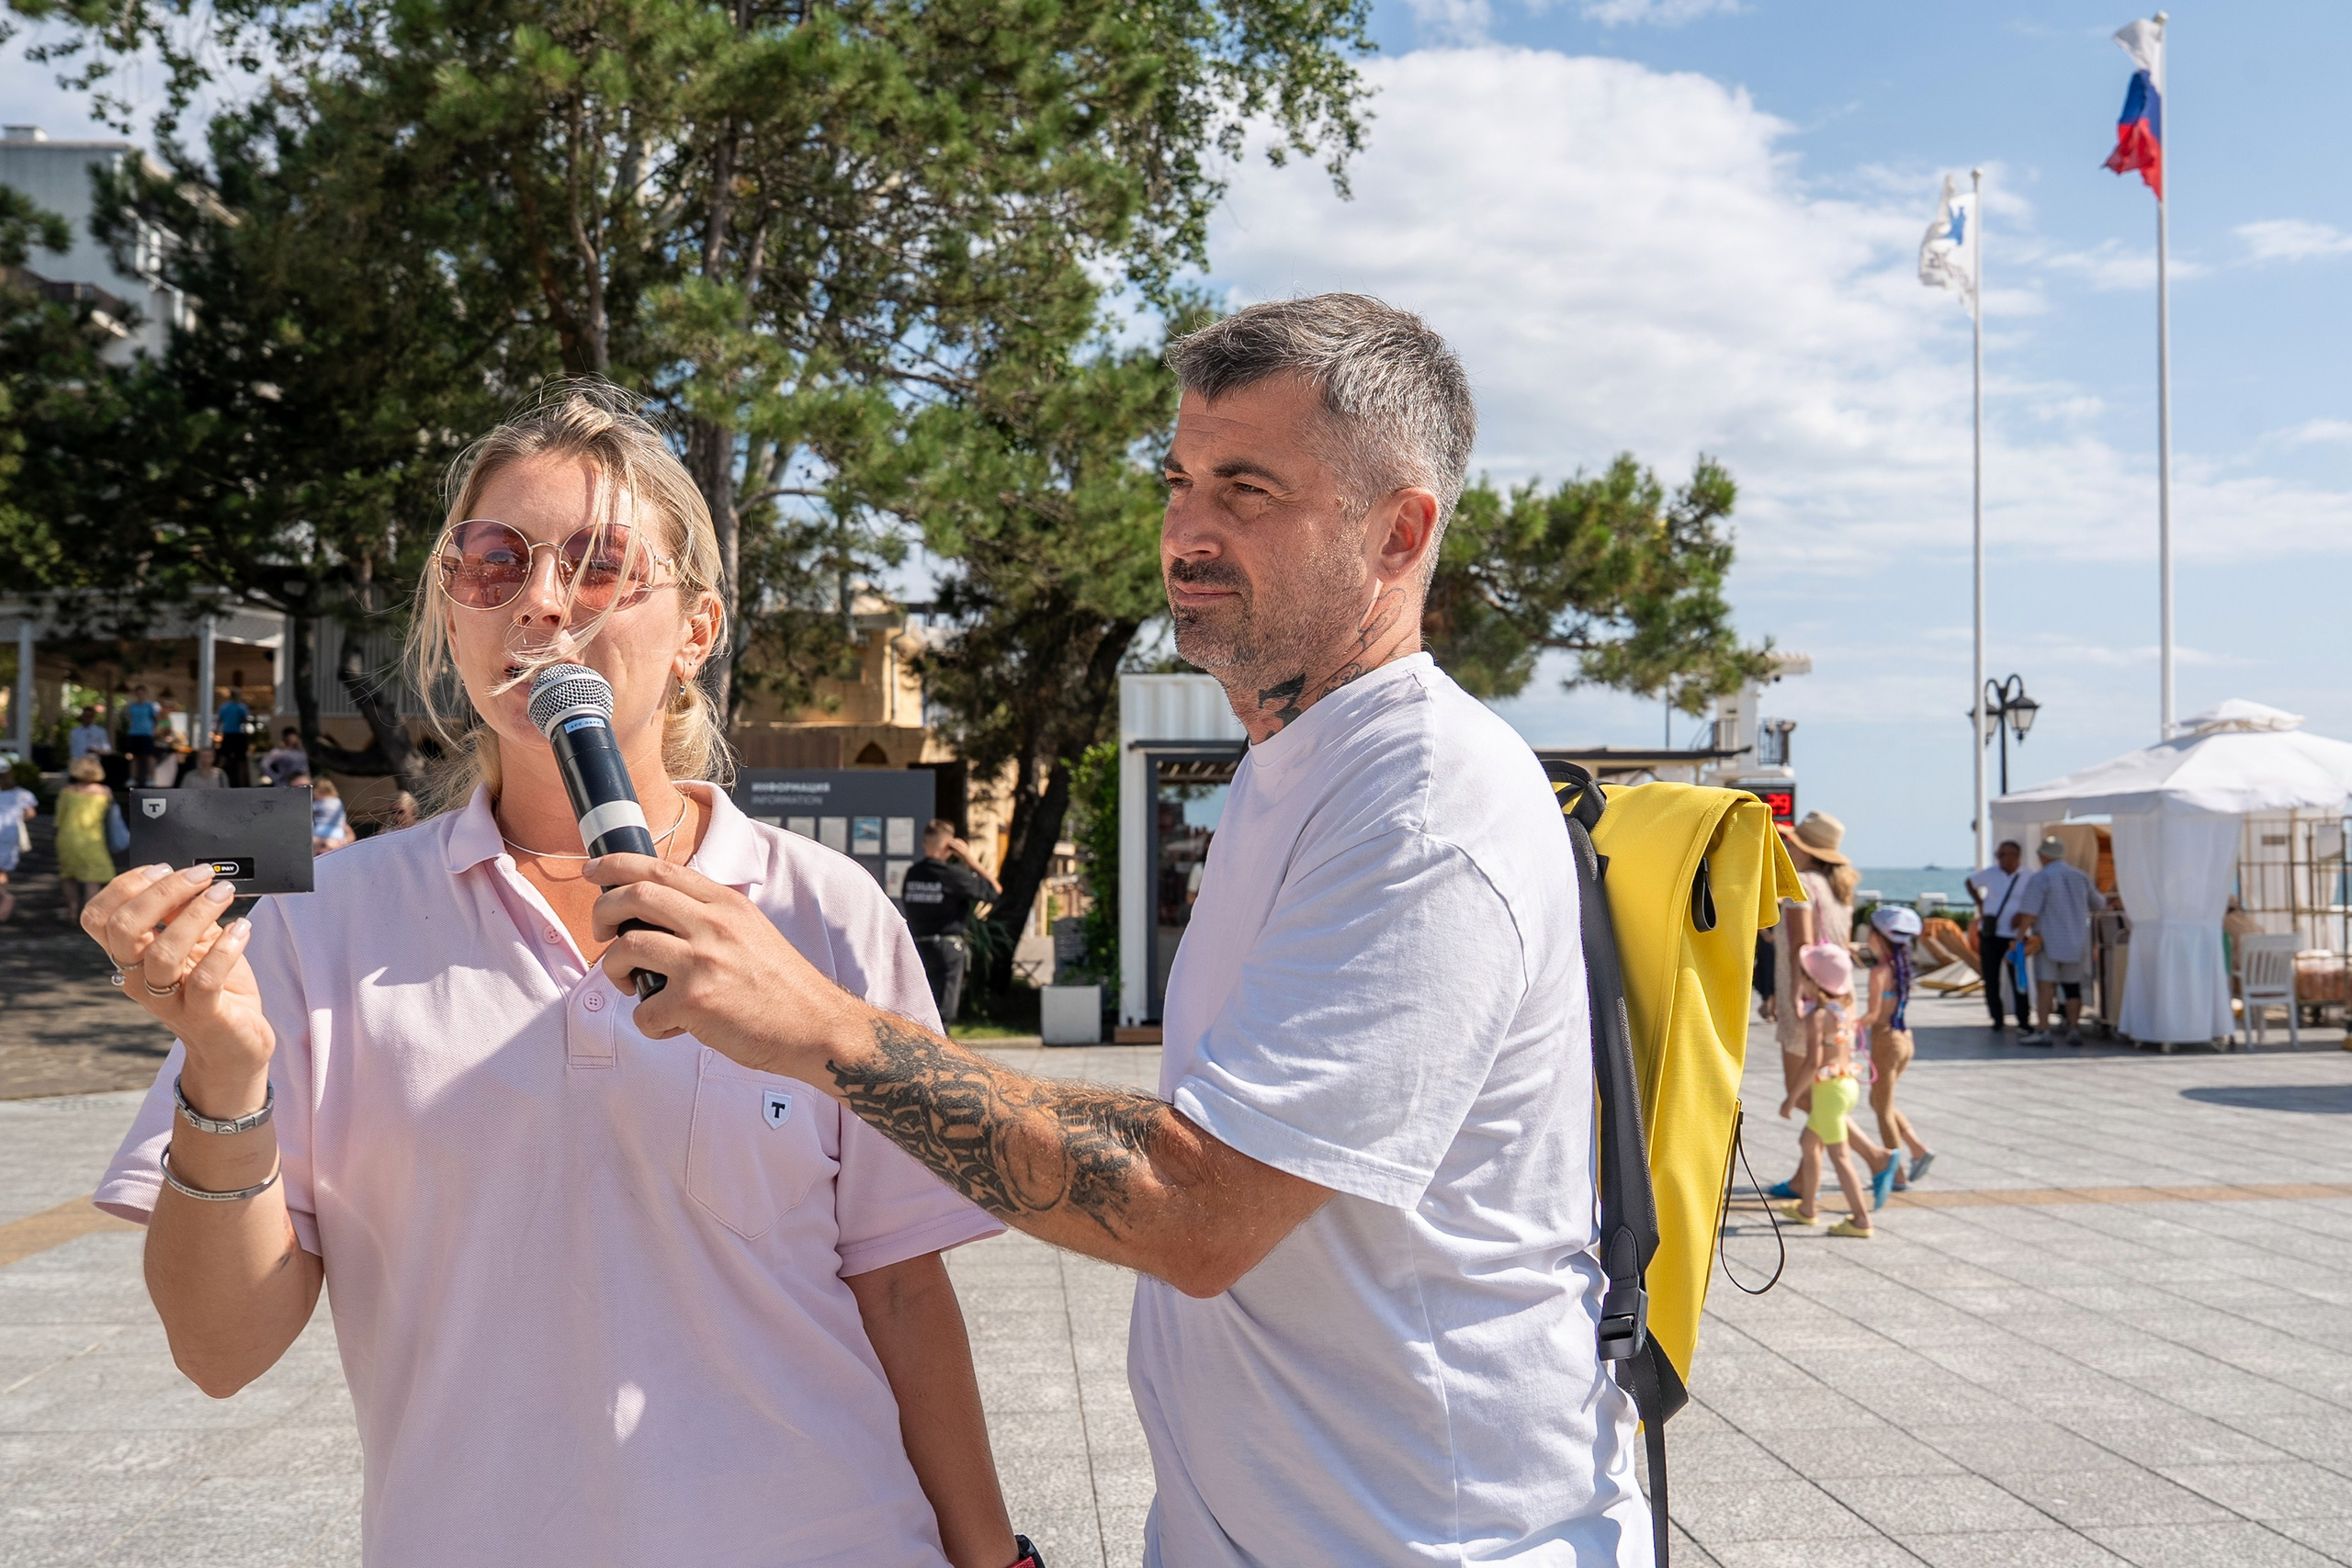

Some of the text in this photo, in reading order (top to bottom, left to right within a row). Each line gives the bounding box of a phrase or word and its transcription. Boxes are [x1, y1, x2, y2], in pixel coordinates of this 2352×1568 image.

[752, 782, 831, 793] ИНФОРМАЦИЯ
[752, 795, 823, 805] INFORMATION
[149, 804, 160, 812] T
[772, 1101, 786, 1119] T
